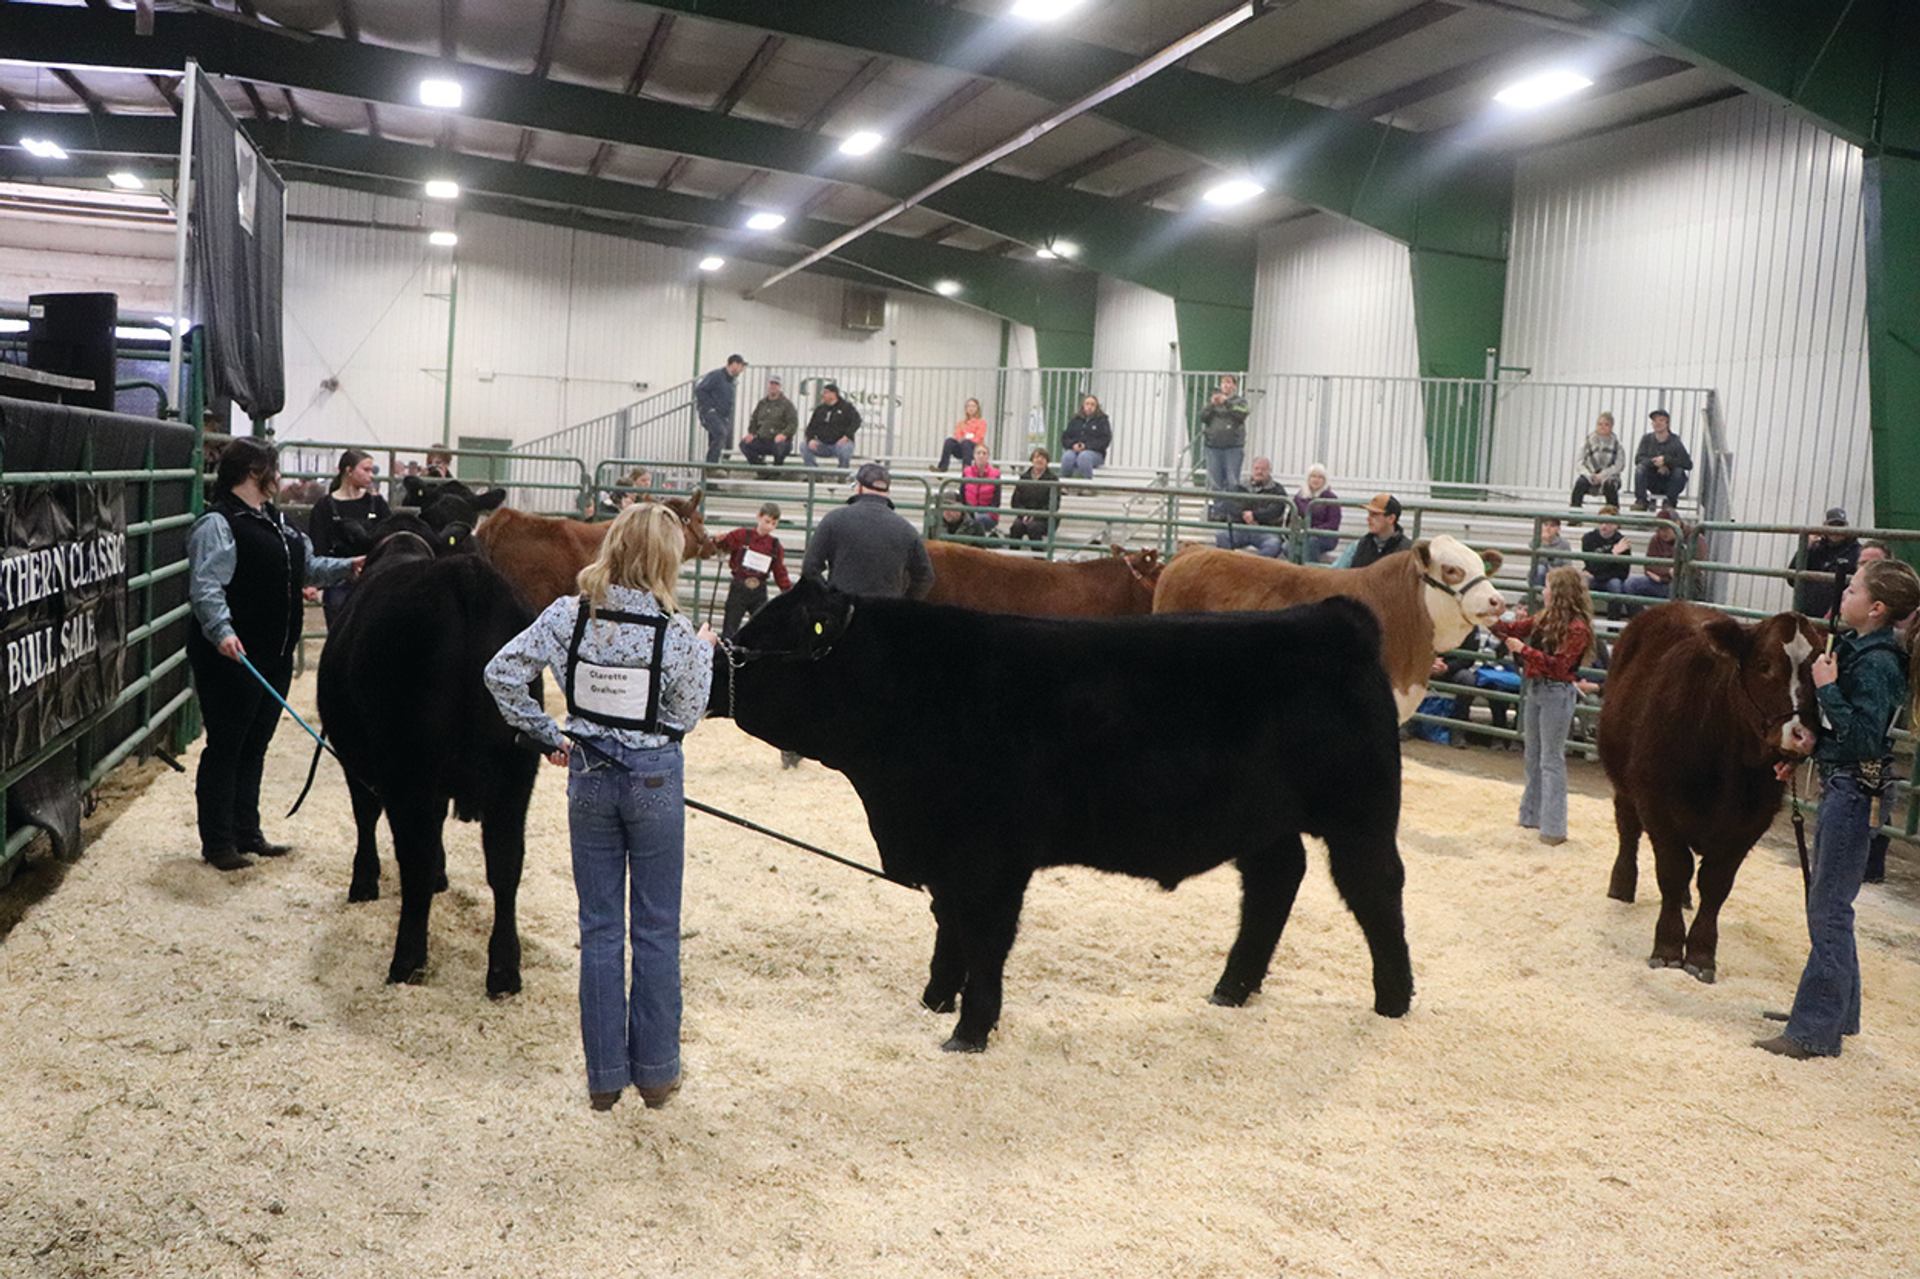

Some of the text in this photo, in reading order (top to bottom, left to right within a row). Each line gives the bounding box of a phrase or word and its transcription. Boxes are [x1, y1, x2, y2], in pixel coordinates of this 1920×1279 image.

[0, 533, 126, 611] THERN CLASSIC
[7, 609, 97, 695] BULL SALE
